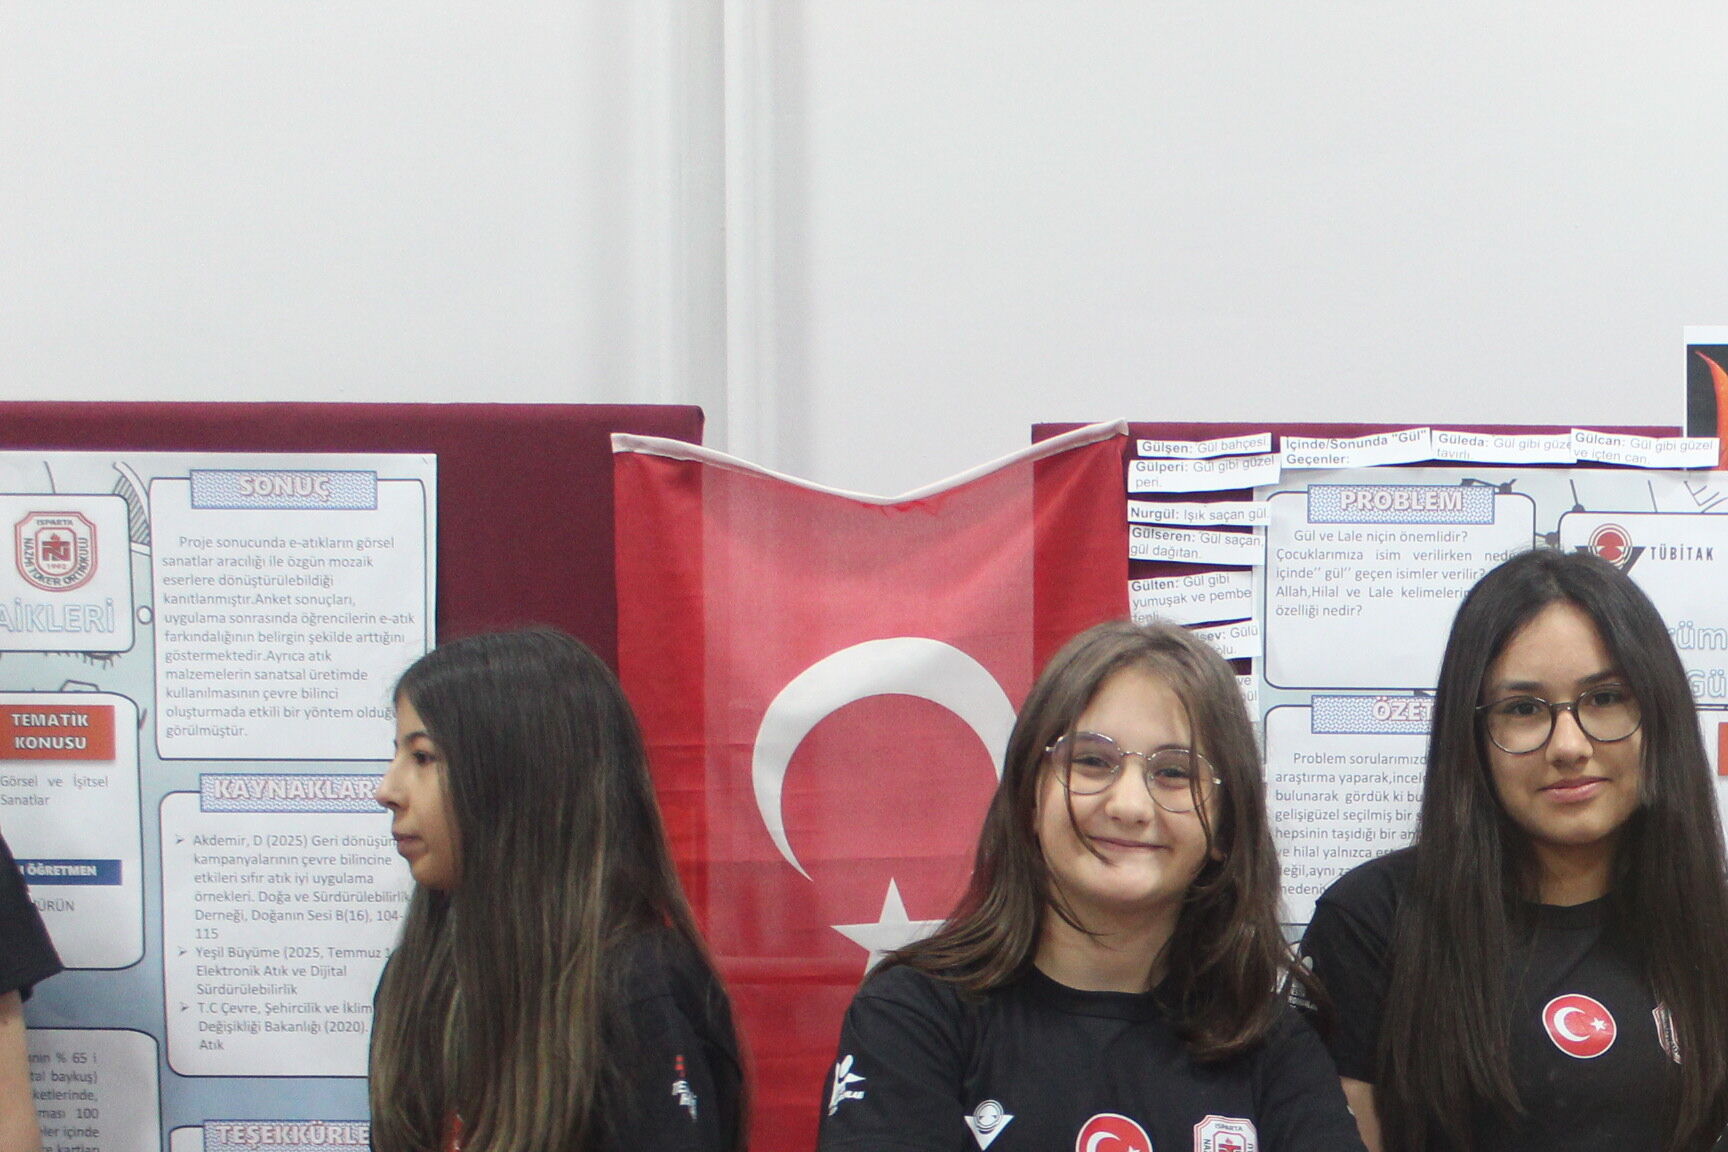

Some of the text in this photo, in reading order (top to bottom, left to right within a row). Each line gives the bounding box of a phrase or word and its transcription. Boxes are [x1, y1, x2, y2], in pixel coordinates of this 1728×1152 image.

[1142, 436, 1267, 454] Gülşen: Gül bahçesi
[1286, 429, 1427, 450] İçinde/Sonunda "Gül"
[1438, 433, 1489, 447] Güleda:
[1575, 432, 1713, 453] Gülcan: Gül gibi güzel
[1136, 456, 1275, 476] Gülperi: Gül gibi güzel
[1286, 453, 1350, 468] Geçenler:
[239, 477, 331, 500] SONUÇ
[1340, 491, 1464, 511] PROBLEM
[1131, 507, 1266, 522] Nurgül: Işık saçan gül
[1132, 527, 1265, 548] Gülseren: Gül saçan,
[1294, 529, 1468, 545] Gül ve Lale niçin önemlidir?
[1274, 547, 1472, 563] Çocuklarımıza isim verilirken
[1651, 544, 1714, 562] TÜBİTAK
[1276, 567, 1486, 582] içinde” gül” geçen isimler verilir?
[1131, 574, 1230, 592] Gülten: Gül gibi
[1132, 587, 1252, 611] yumuşak ve pembe
[1275, 585, 1394, 599] Allah,Hilal ve Lale
[1275, 604, 1362, 619] özelliği nedir?
[12, 711, 89, 727] TEMATİK
[15, 736, 87, 749] KONUSU
[0, 773, 109, 789] Görsel ve İşitsel
[29, 862, 97, 876] ÖĞRETMEN
